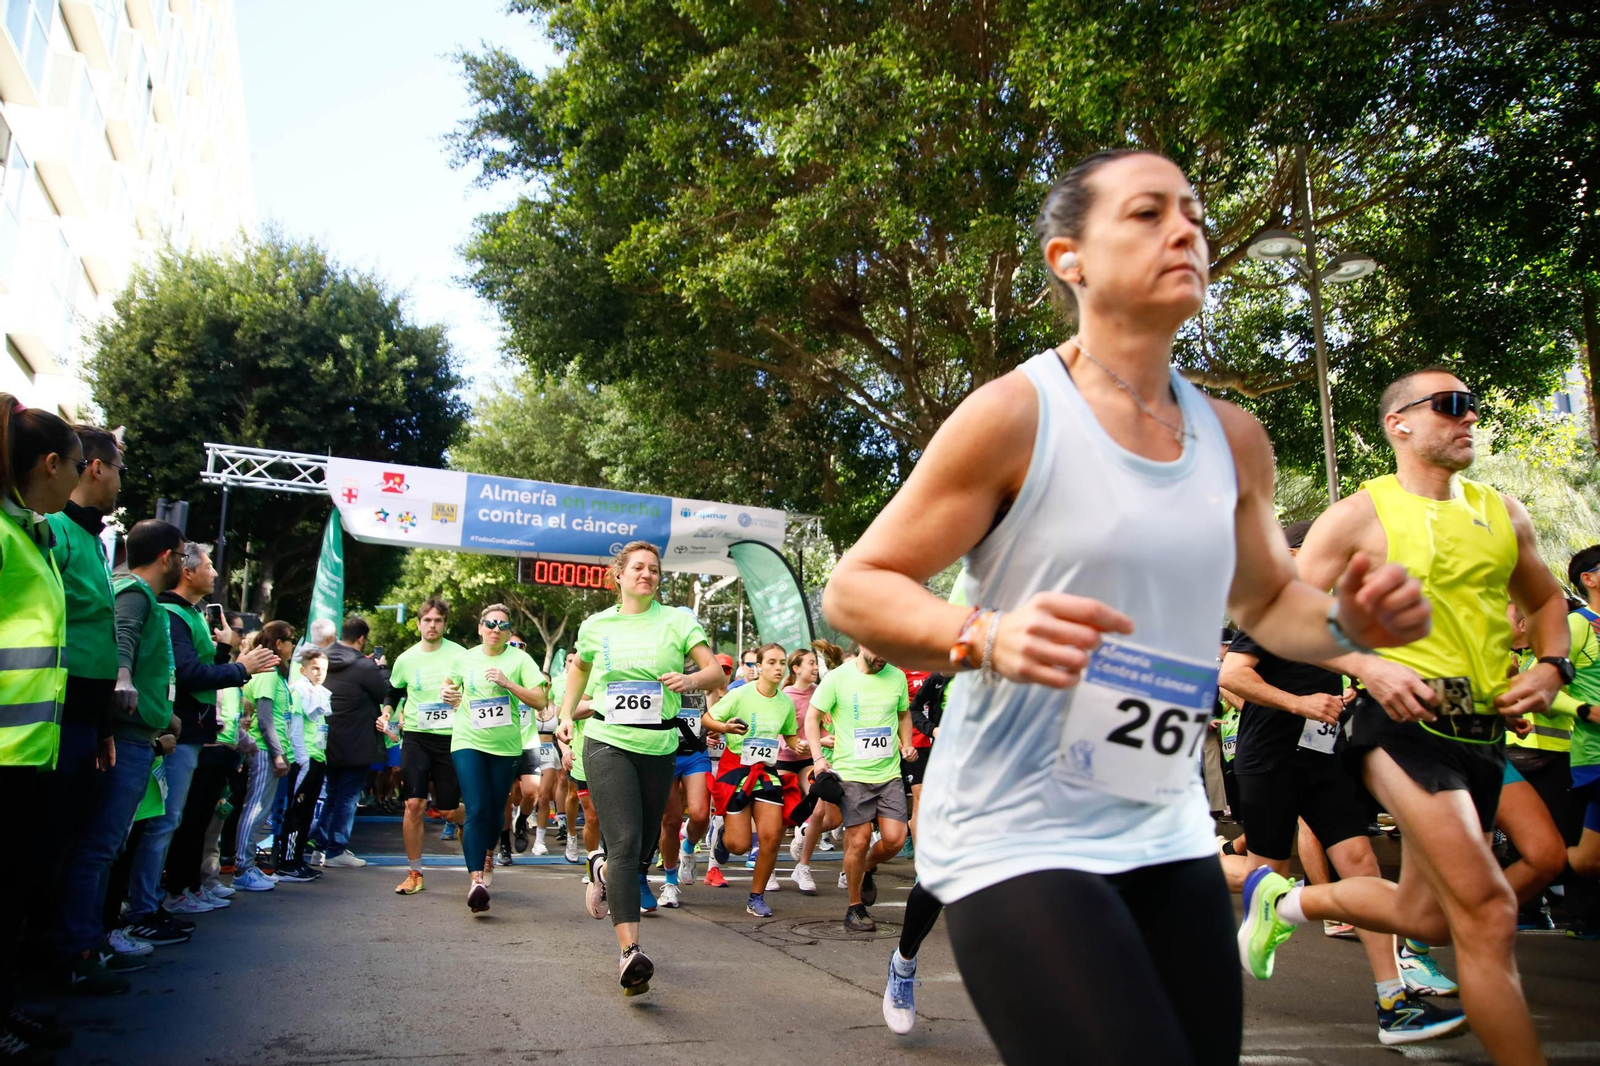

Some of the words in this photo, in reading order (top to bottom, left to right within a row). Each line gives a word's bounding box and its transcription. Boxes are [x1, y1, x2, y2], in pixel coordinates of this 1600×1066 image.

[480, 484, 557, 507] Almería
[562, 496, 585, 509] en
[590, 497, 660, 518] marcha
[478, 508, 543, 528] contra
[548, 513, 567, 529] el
[572, 515, 638, 537] cáncer
[613, 659, 658, 671] cáncer
[614, 694, 652, 711] 266
[425, 711, 448, 721] 755
[478, 706, 504, 719] 312
[1106, 697, 1210, 758] 267
[862, 736, 888, 749] 740
[750, 746, 772, 758] 742
